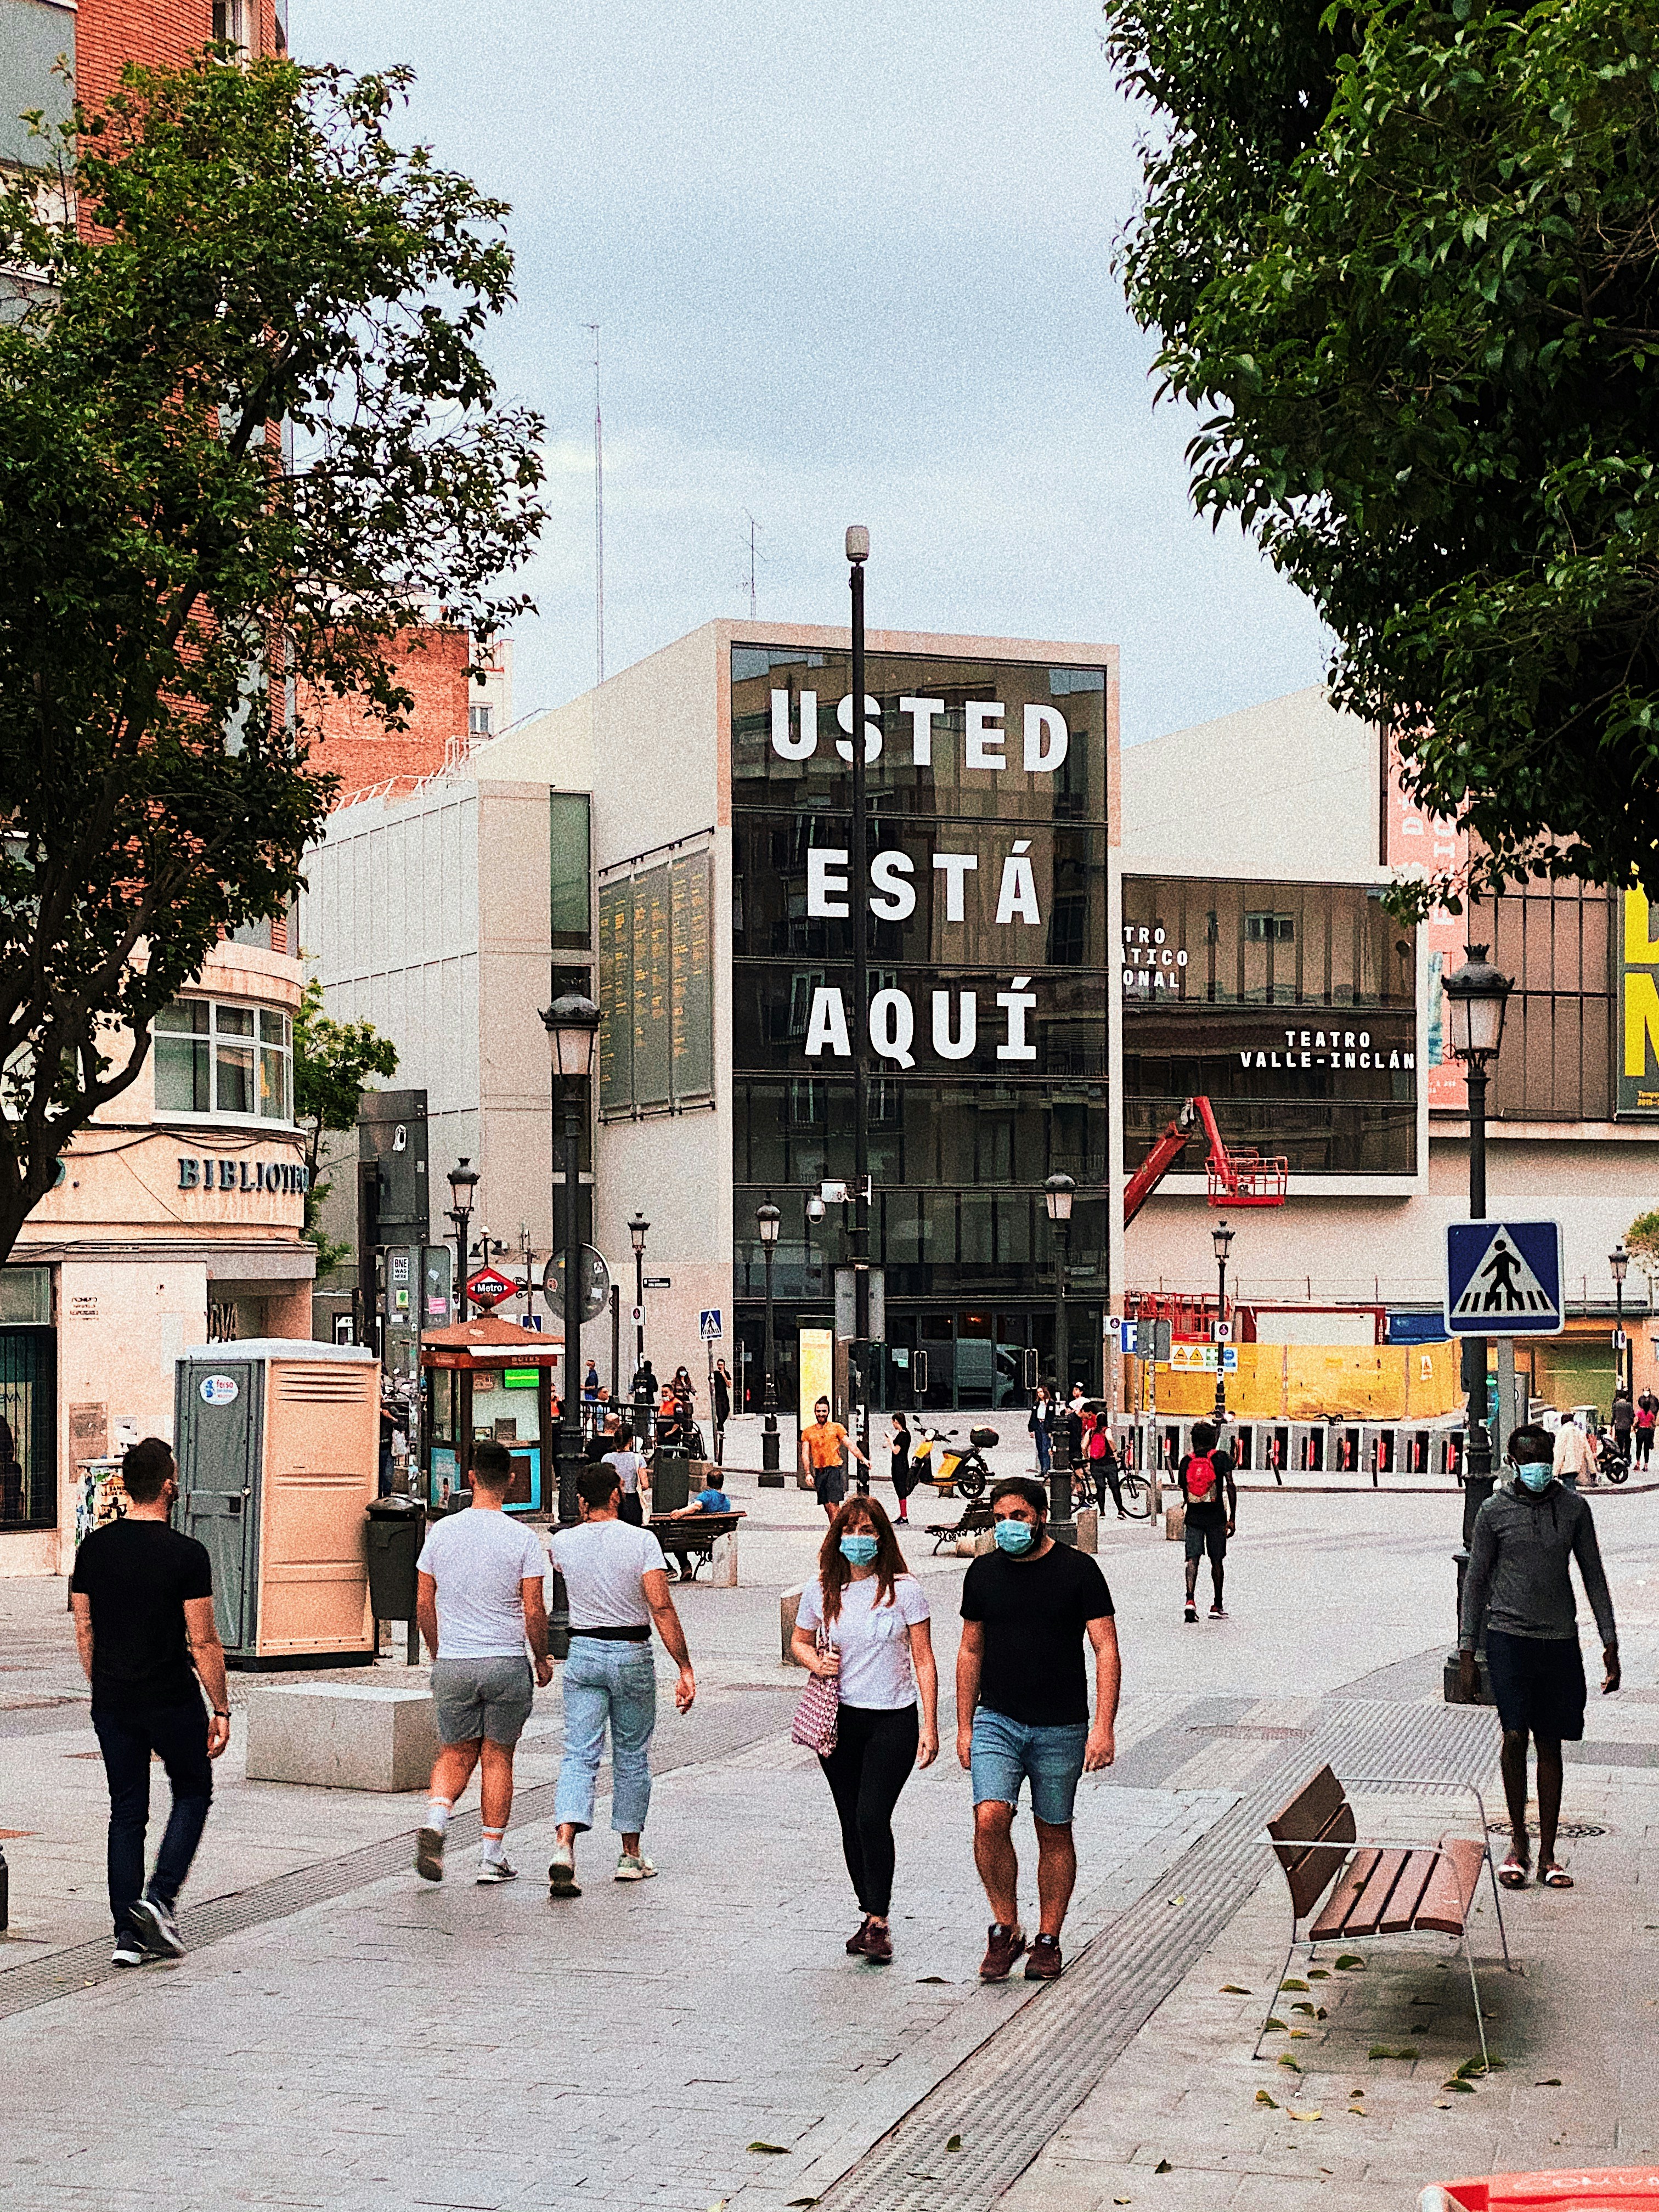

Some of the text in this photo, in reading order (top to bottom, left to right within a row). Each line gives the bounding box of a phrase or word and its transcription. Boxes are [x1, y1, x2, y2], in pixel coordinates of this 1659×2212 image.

[771, 689, 1069, 772] USTED
[807, 840, 1041, 925] ESTÁ
[804, 976, 1037, 1070] AQUÍ
[1285, 1031, 1370, 1047] TEATRO
[1240, 1050, 1414, 1068] VALLE-INCLÁN
[395, 1259, 407, 1268] BNE
[477, 1284, 503, 1293] Metro
